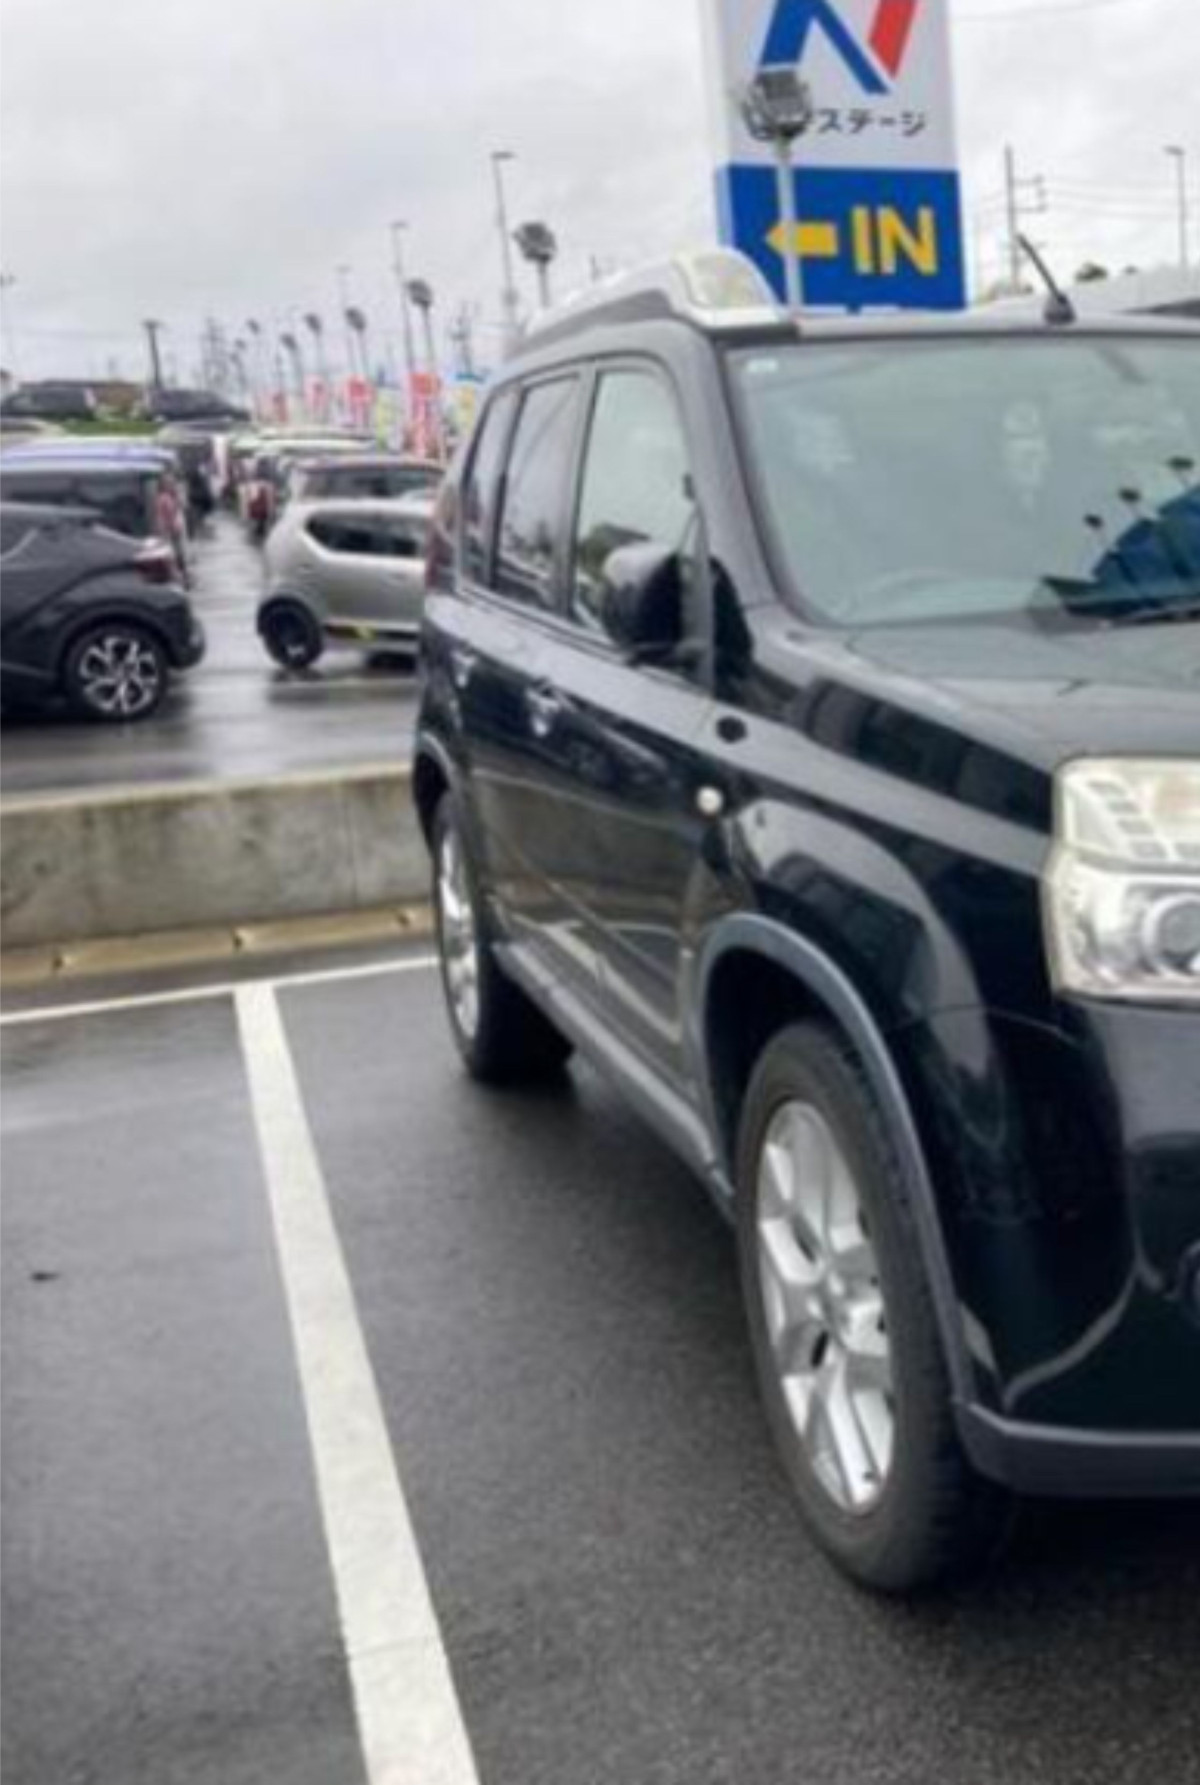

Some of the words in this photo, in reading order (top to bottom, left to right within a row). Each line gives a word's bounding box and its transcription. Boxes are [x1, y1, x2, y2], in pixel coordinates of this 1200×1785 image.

[817, 108, 926, 137] ステージ
[852, 206, 937, 274] IN
